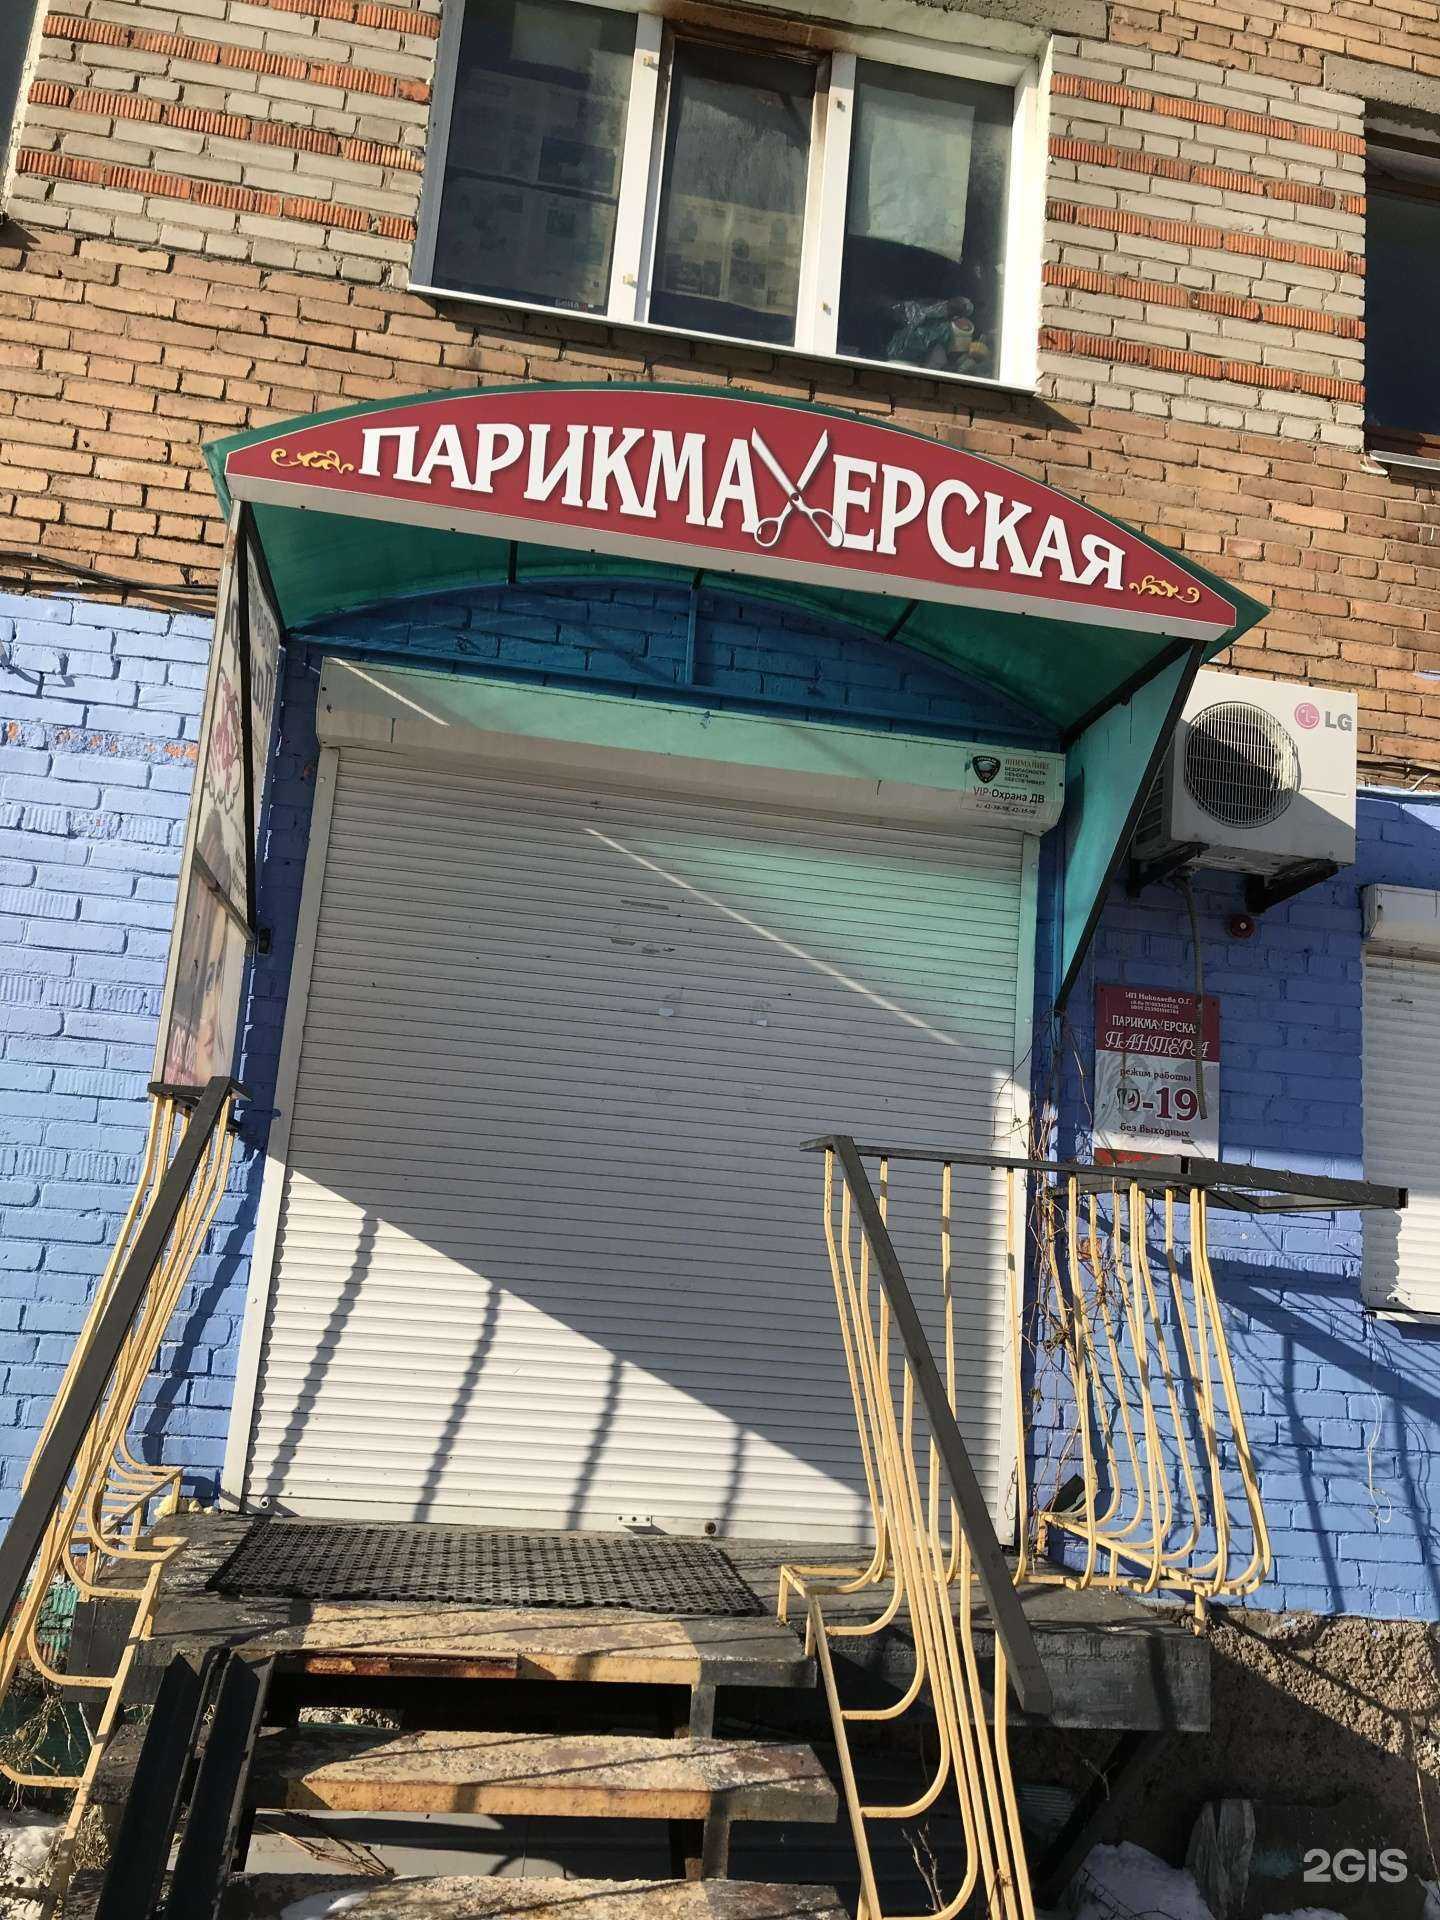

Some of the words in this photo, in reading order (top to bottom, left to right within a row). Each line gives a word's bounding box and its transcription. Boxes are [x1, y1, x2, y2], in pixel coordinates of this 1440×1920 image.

[360, 424, 1126, 591] ПАРИКМАХЕРСКАЯ
[1325, 711, 1352, 732] LG
[1029, 793, 1045, 805] ДВ
[1153, 1071, 1192, 1082] работы
[1120, 1122, 1137, 1132] без
[1139, 1124, 1191, 1138] выходных
